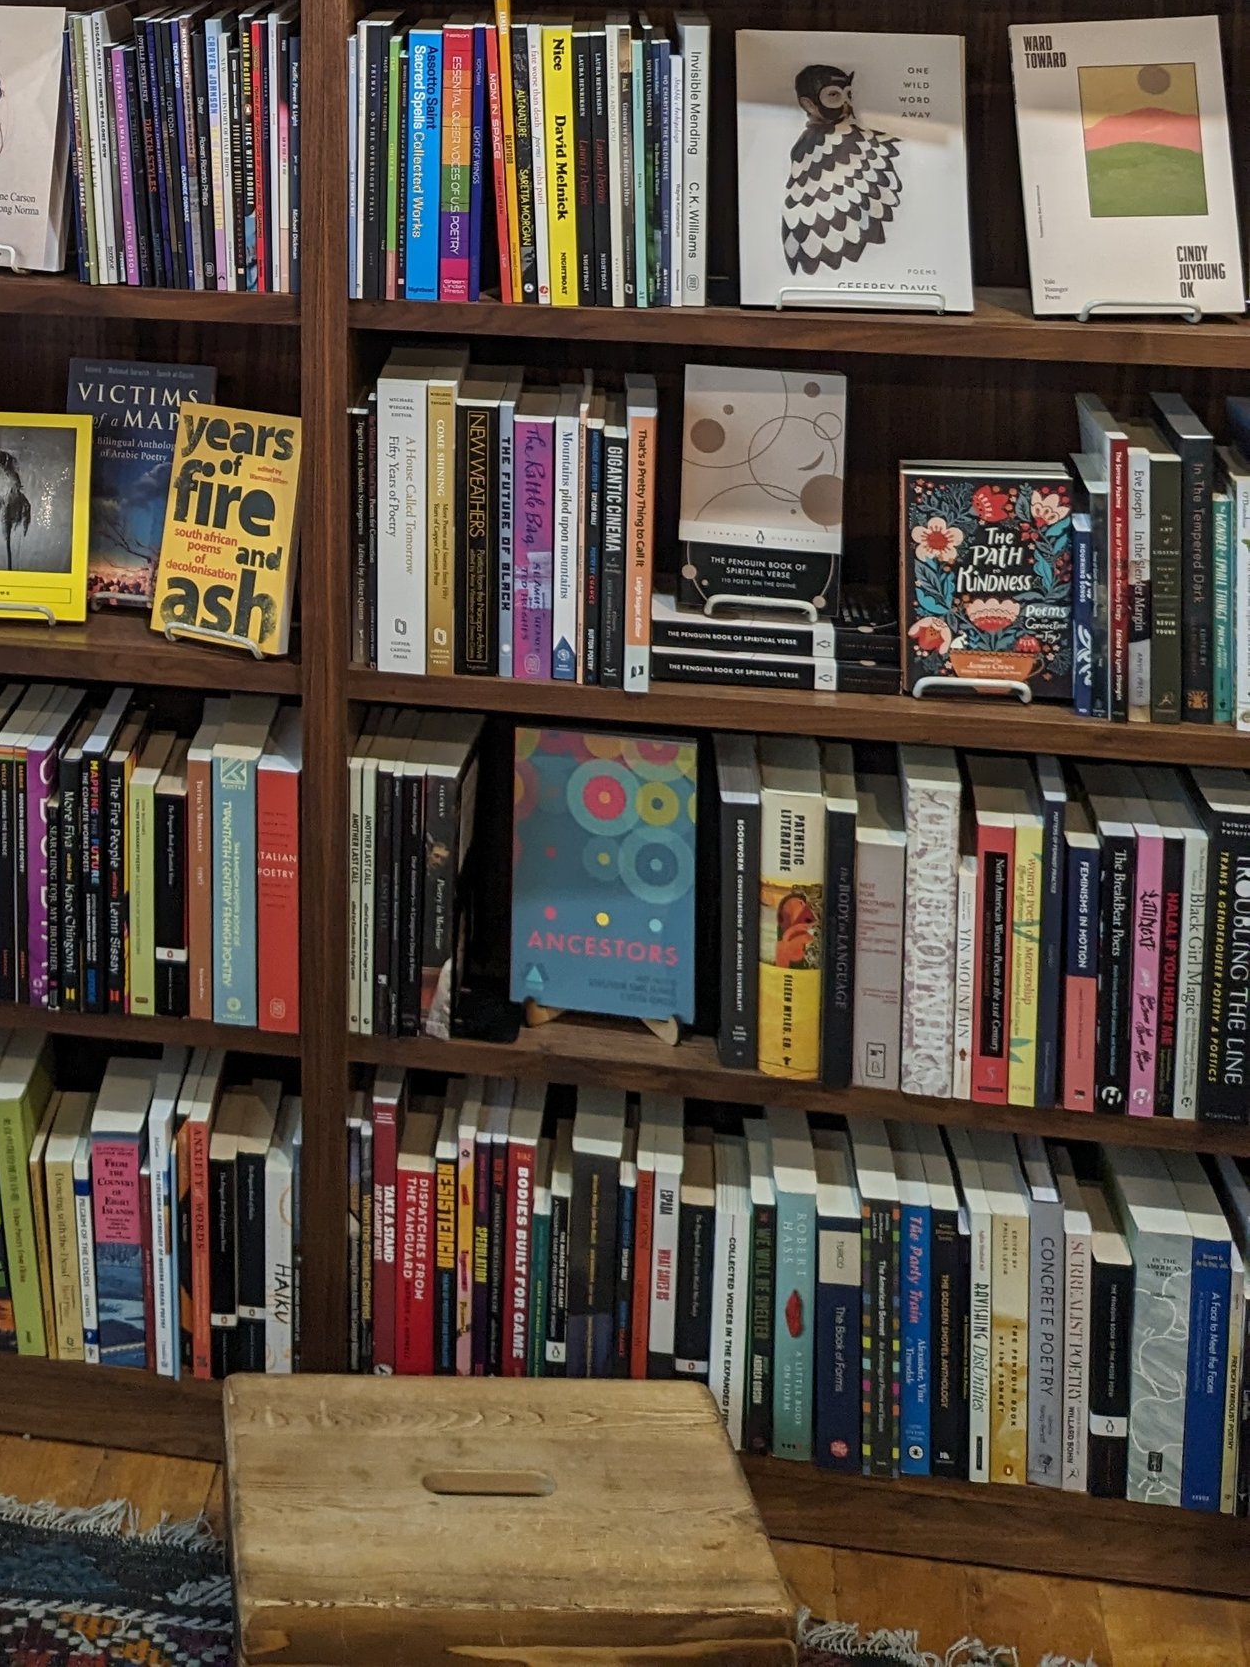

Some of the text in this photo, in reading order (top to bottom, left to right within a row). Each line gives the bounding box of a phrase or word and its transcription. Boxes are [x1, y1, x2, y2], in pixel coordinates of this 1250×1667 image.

[1023, 36, 1052, 52] WARD
[1025, 52, 1067, 68] TOWARD
[688, 51, 702, 156] Invisible Mending
[552, 38, 567, 221] Nice David Melnick
[10, 193, 35, 202] Carson
[14, 206, 39, 215] Norma
[1177, 246, 1208, 262] CINDY
[1179, 263, 1226, 280] JUYOUNG
[1180, 282, 1195, 298] OK
[78, 382, 199, 406] VICTIMS
[111, 417, 118, 427] a
[124, 412, 179, 431] MAP
[182, 414, 294, 461] years
[174, 458, 276, 537] fire
[606, 447, 623, 551] GIGANTIC CINEMA
[235, 545, 283, 571] and
[711, 556, 806, 571] THE PENGUIN BOOK OF
[726, 567, 791, 580] SPIRITUAL VERSE
[160, 571, 277, 643] ash
[780, 809, 805, 873] PATHETIC LITERATURE
[258, 868, 294, 878] POETRY
[528, 931, 678, 966] ANCESTORS
[512, 1167, 529, 1359] BODIES BUILT FOR GAME
[275, 1264, 292, 1325] HAIKU
[1039, 1237, 1055, 1397] CONCRETE POETRY
